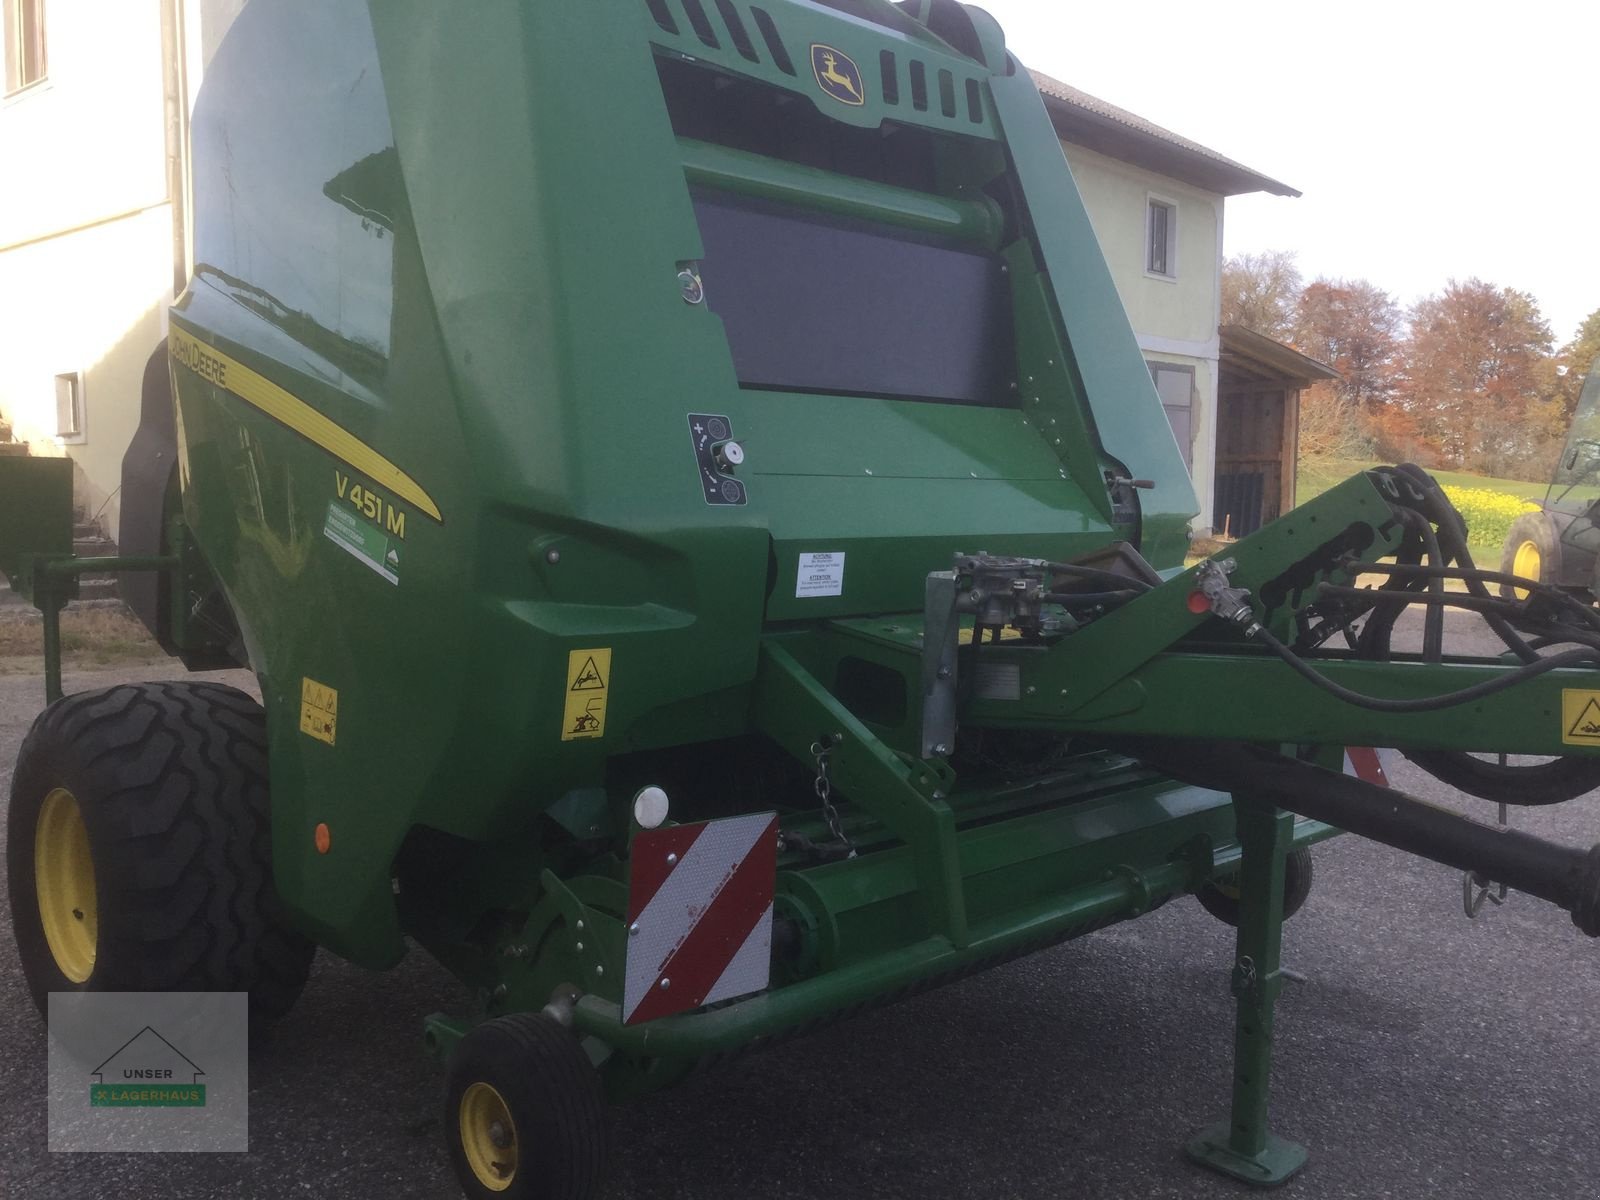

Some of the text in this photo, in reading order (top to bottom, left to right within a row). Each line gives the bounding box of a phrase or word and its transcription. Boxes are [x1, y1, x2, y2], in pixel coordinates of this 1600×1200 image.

[171, 336, 226, 386] JOHN DEERE
[335, 470, 405, 539] V 451 M
